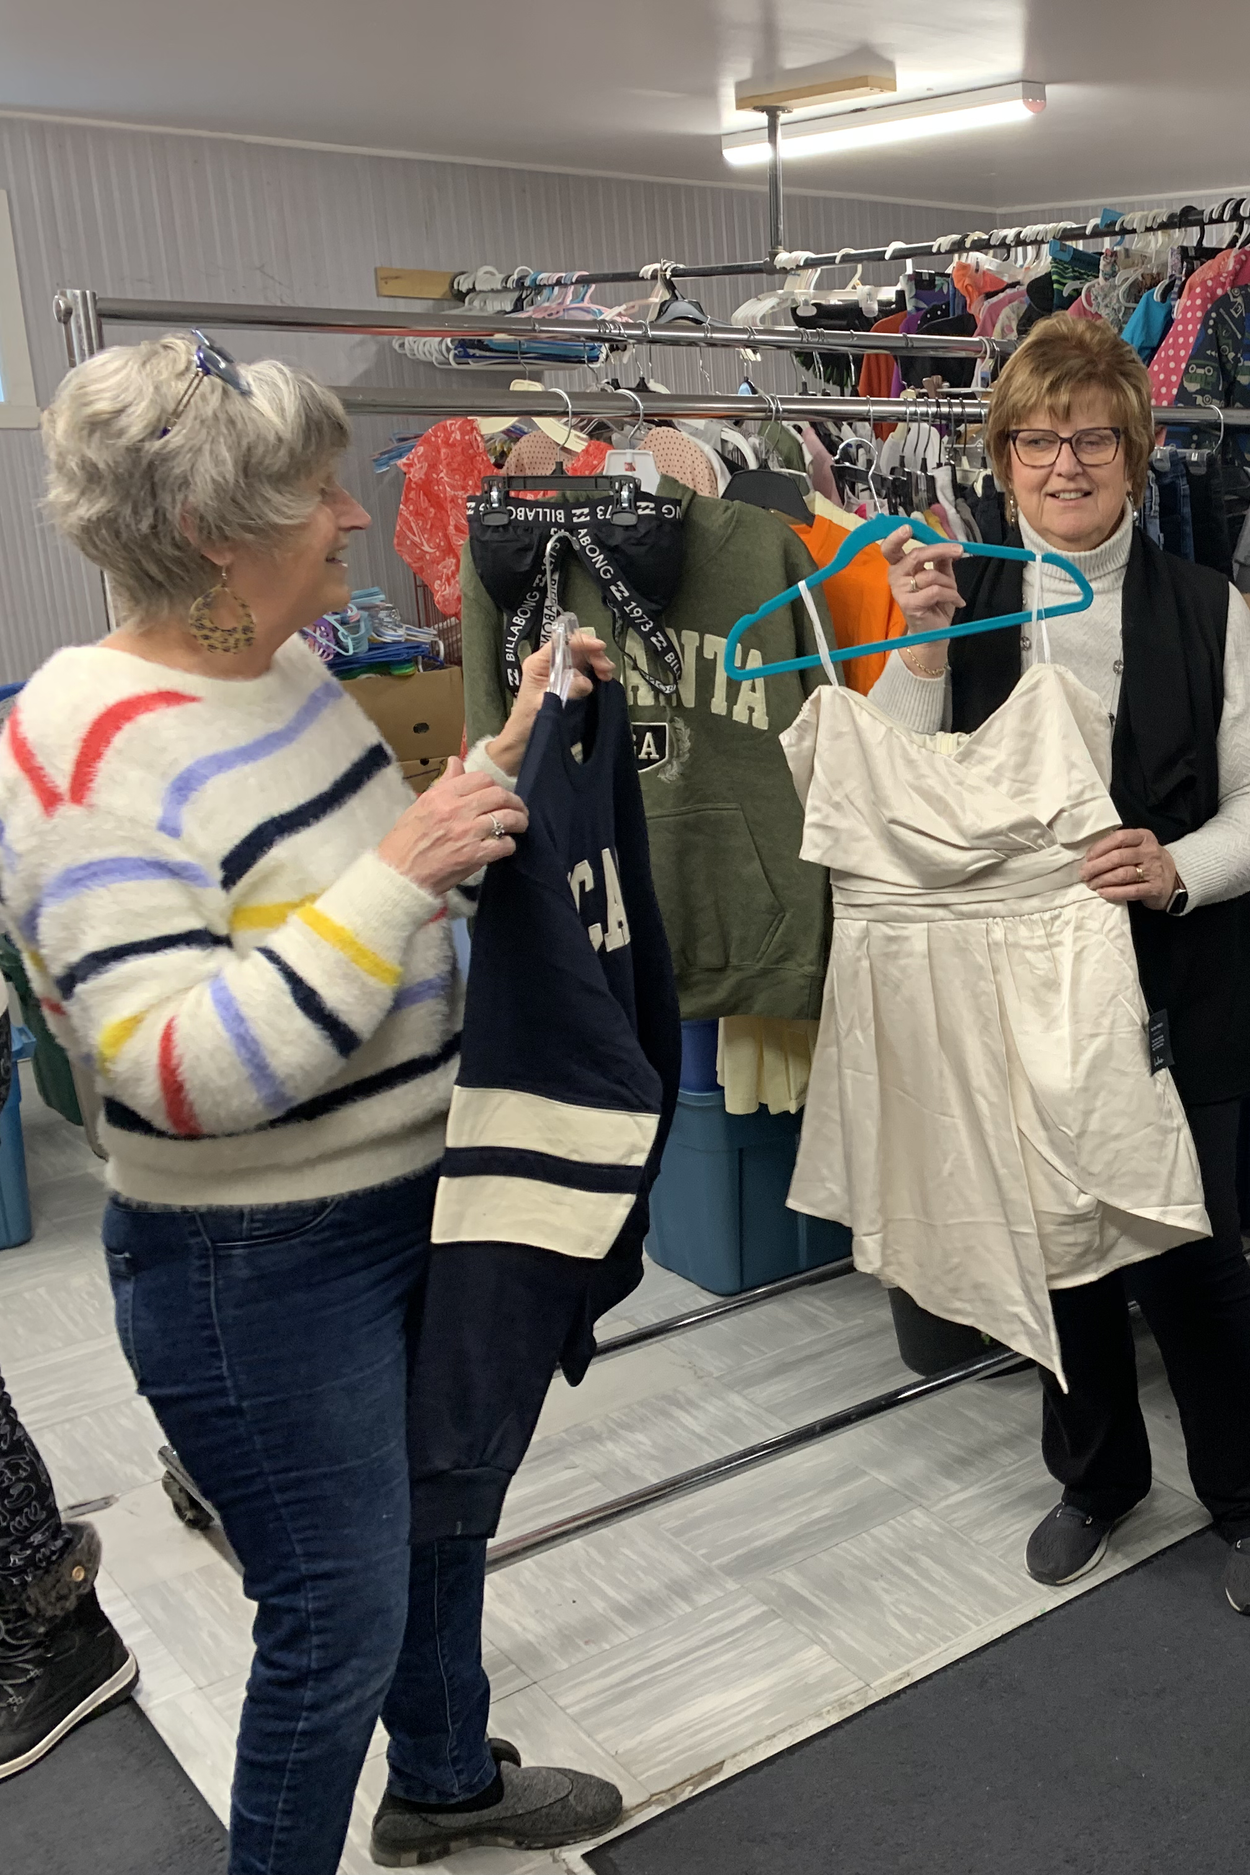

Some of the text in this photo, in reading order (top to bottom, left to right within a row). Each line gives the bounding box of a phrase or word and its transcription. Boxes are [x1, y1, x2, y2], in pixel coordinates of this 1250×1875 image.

[577, 527, 614, 581] ABONG
[623, 600, 654, 632] 1973
[505, 591, 540, 662] BILLABONG
